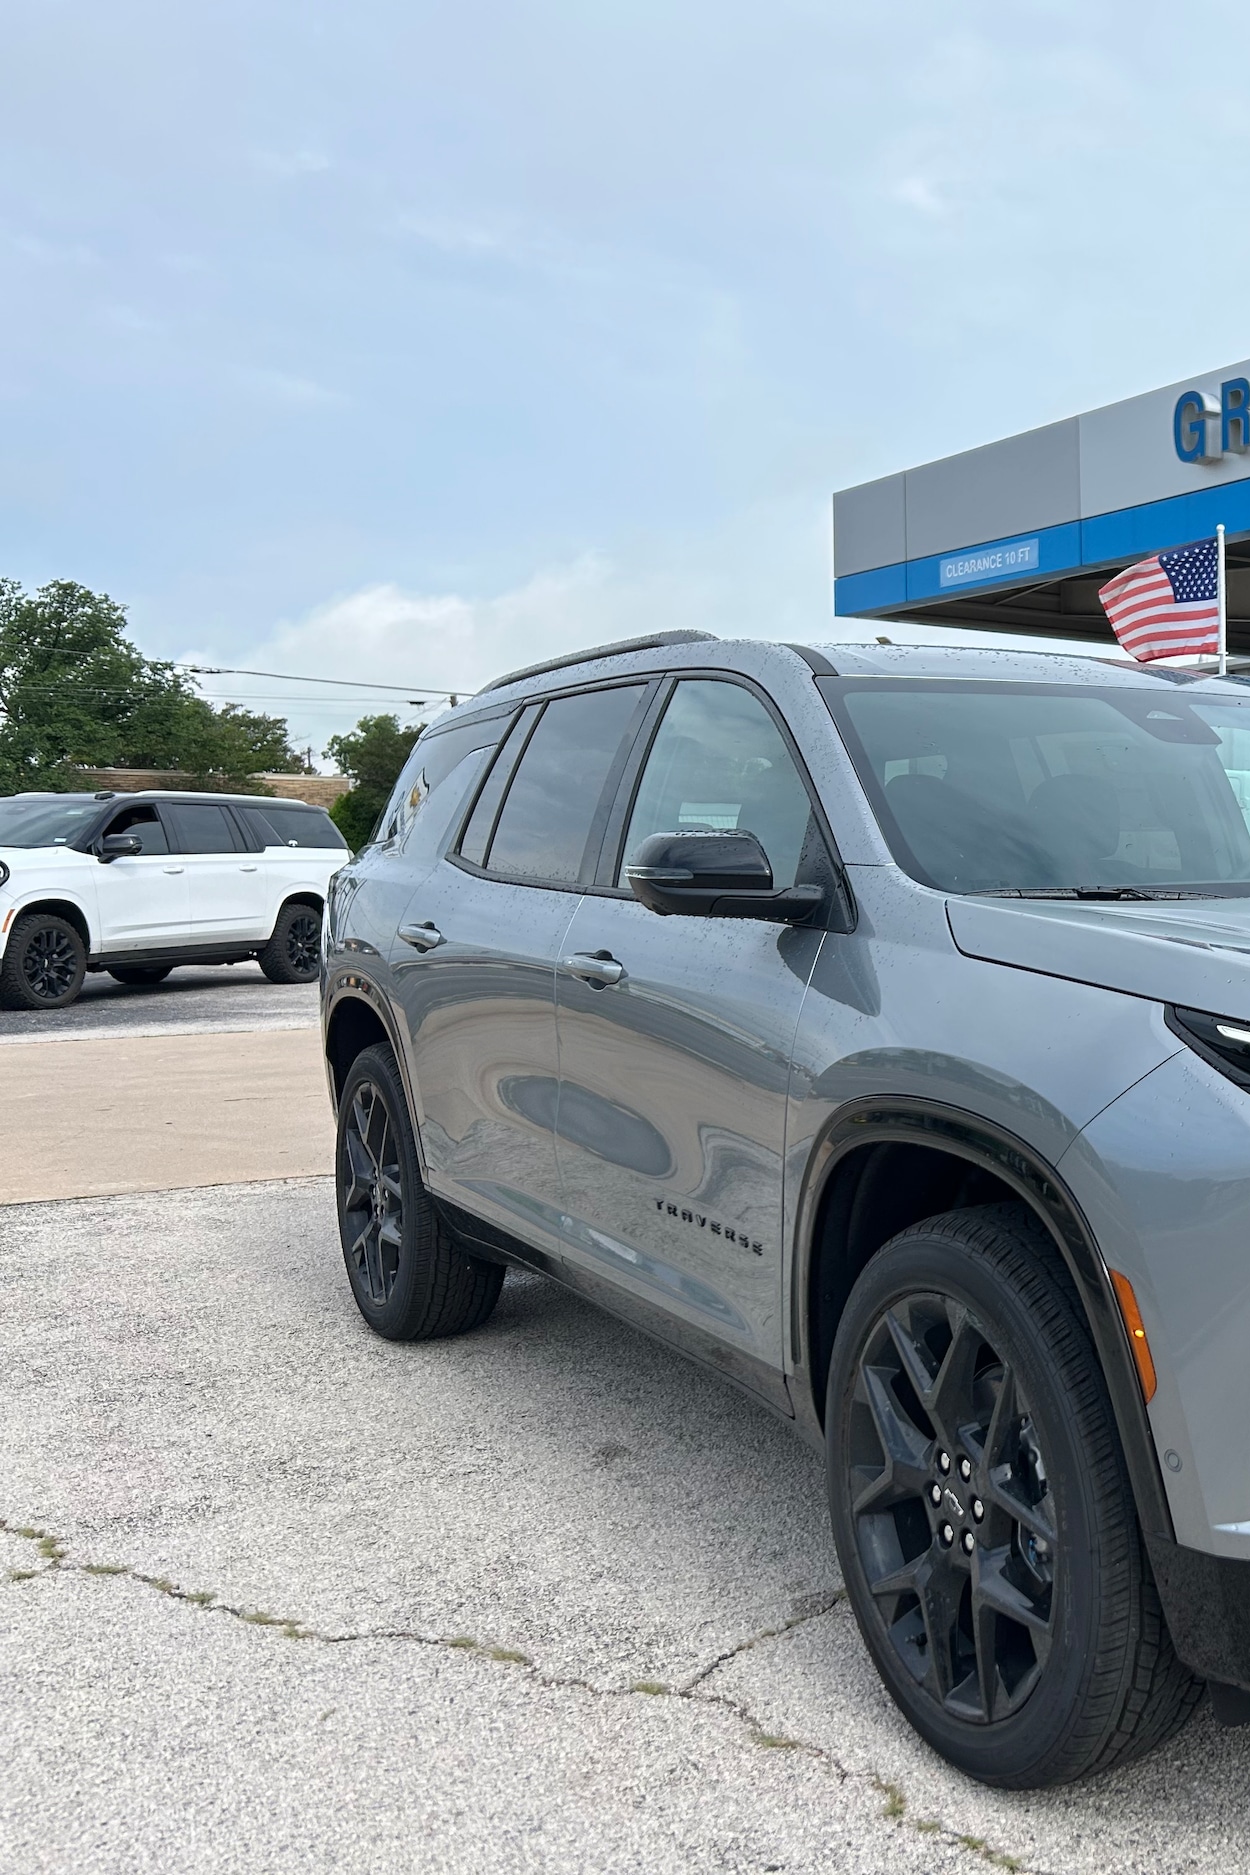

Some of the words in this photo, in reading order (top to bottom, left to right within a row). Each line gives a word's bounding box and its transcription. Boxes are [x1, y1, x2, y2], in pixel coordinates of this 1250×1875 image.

[946, 553, 1003, 578] CLEARANCE
[1005, 551, 1016, 565] 10
[1018, 547, 1031, 563] FT
[654, 1199, 763, 1256] TRAVERSE
